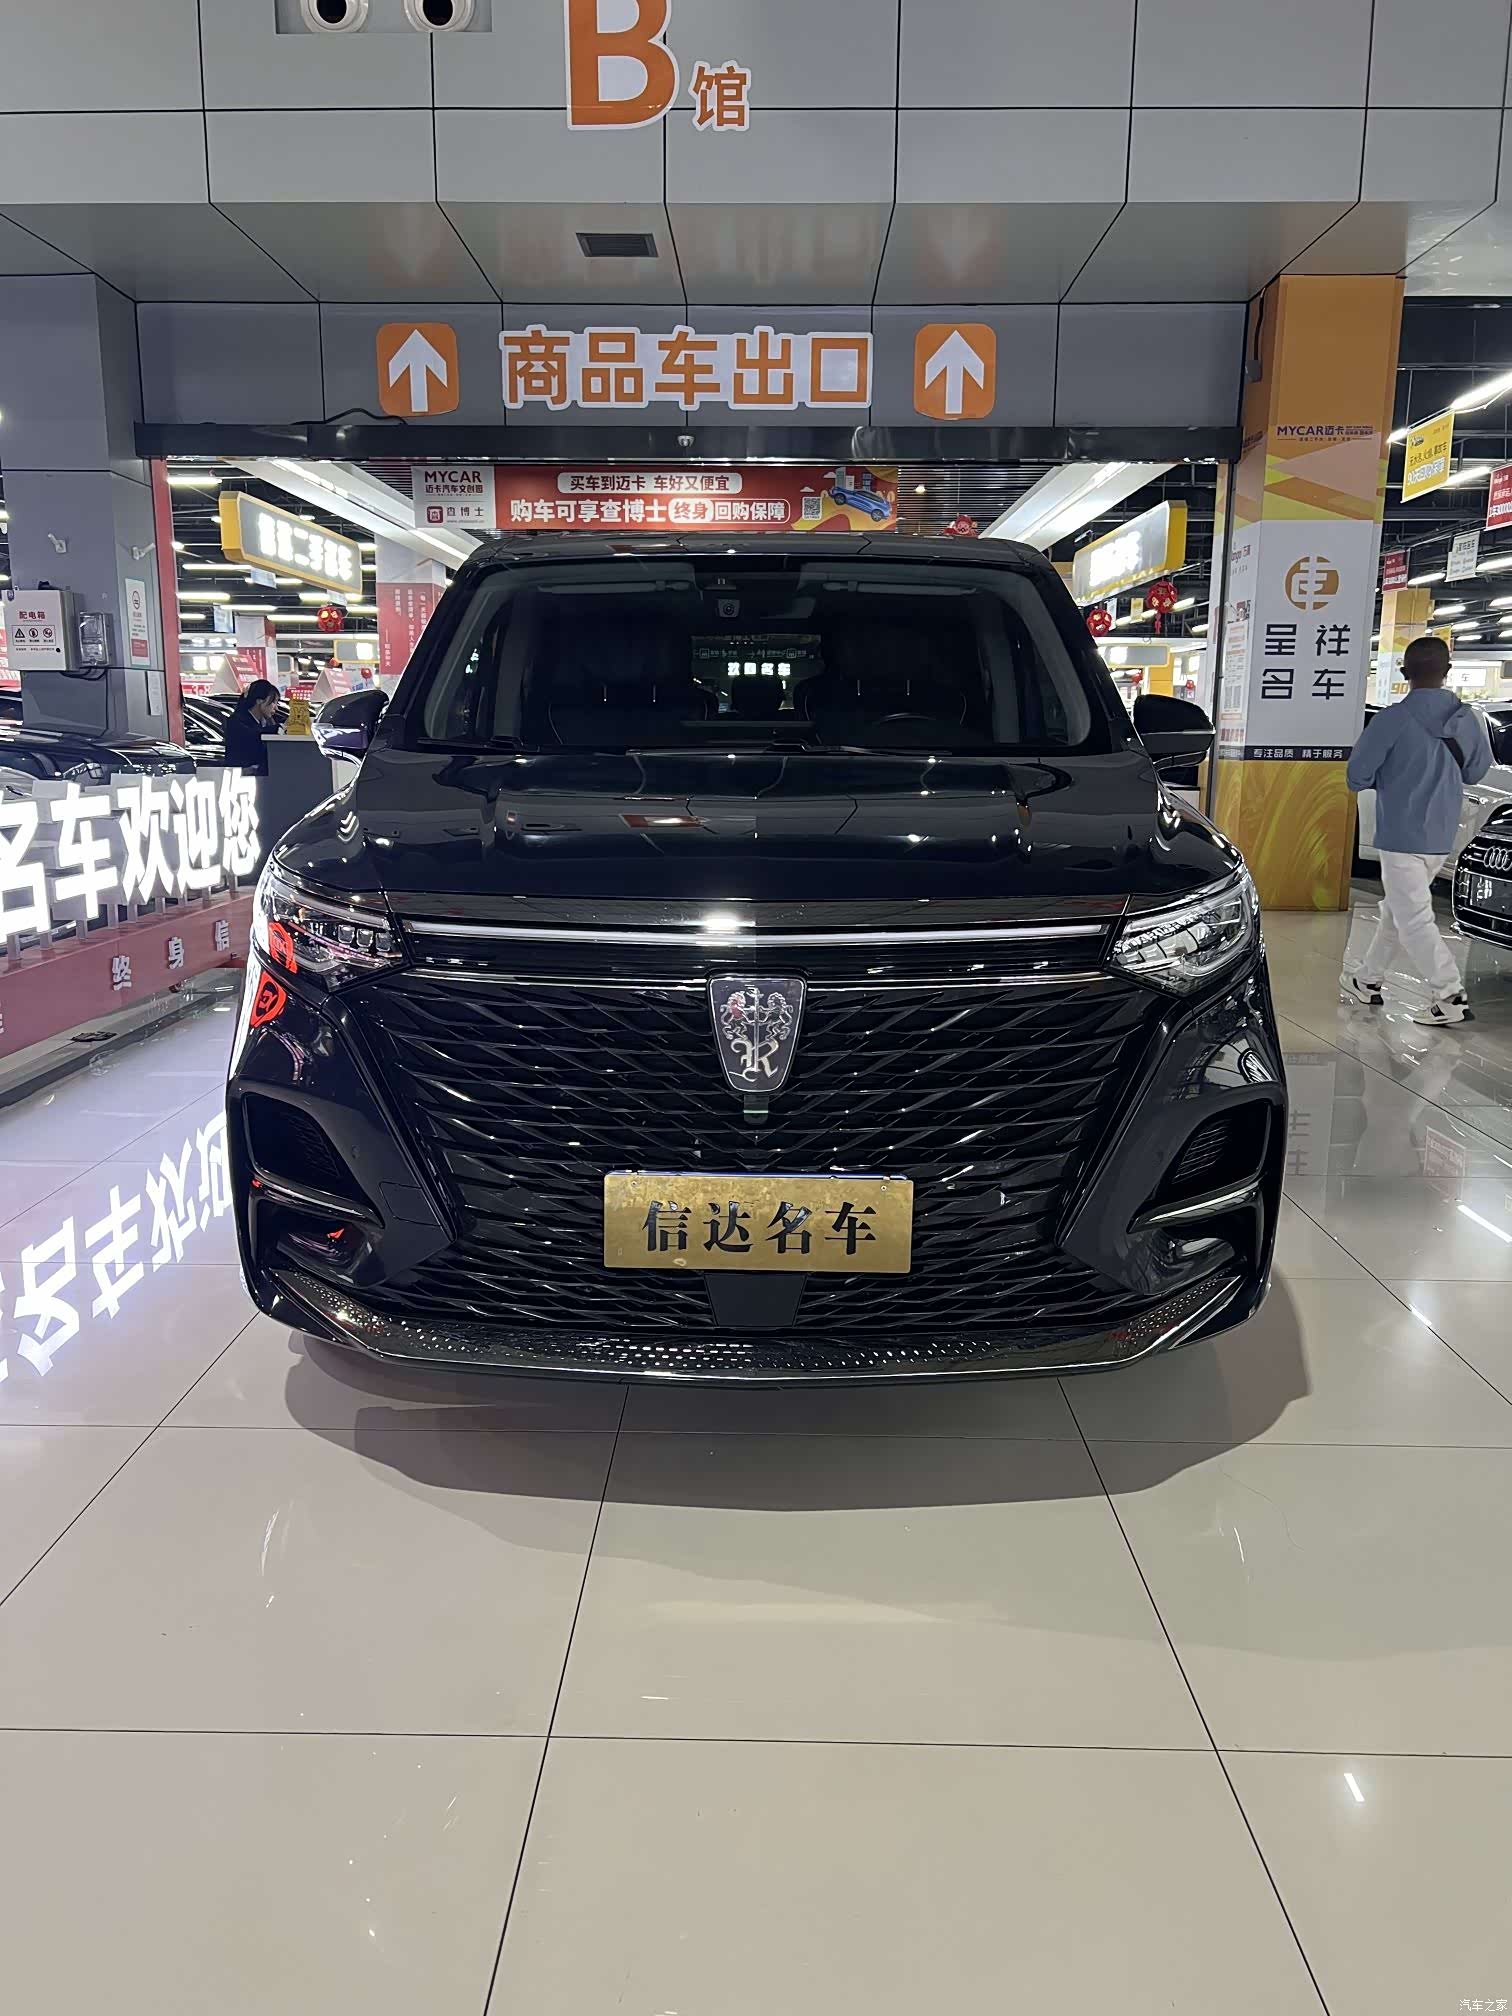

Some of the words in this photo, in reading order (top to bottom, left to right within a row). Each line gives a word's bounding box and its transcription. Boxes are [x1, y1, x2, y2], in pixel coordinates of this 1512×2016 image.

[501, 327, 870, 407] 商品车出口
[424, 470, 482, 483] MYCAR
[570, 475, 646, 491] 买车到迈卡
[653, 475, 730, 491] 车好又便宜
[19, 610, 46, 620] 配电箱
[1253, 748, 1294, 758] 专注品质
[642, 1200, 877, 1255] 信达名车
